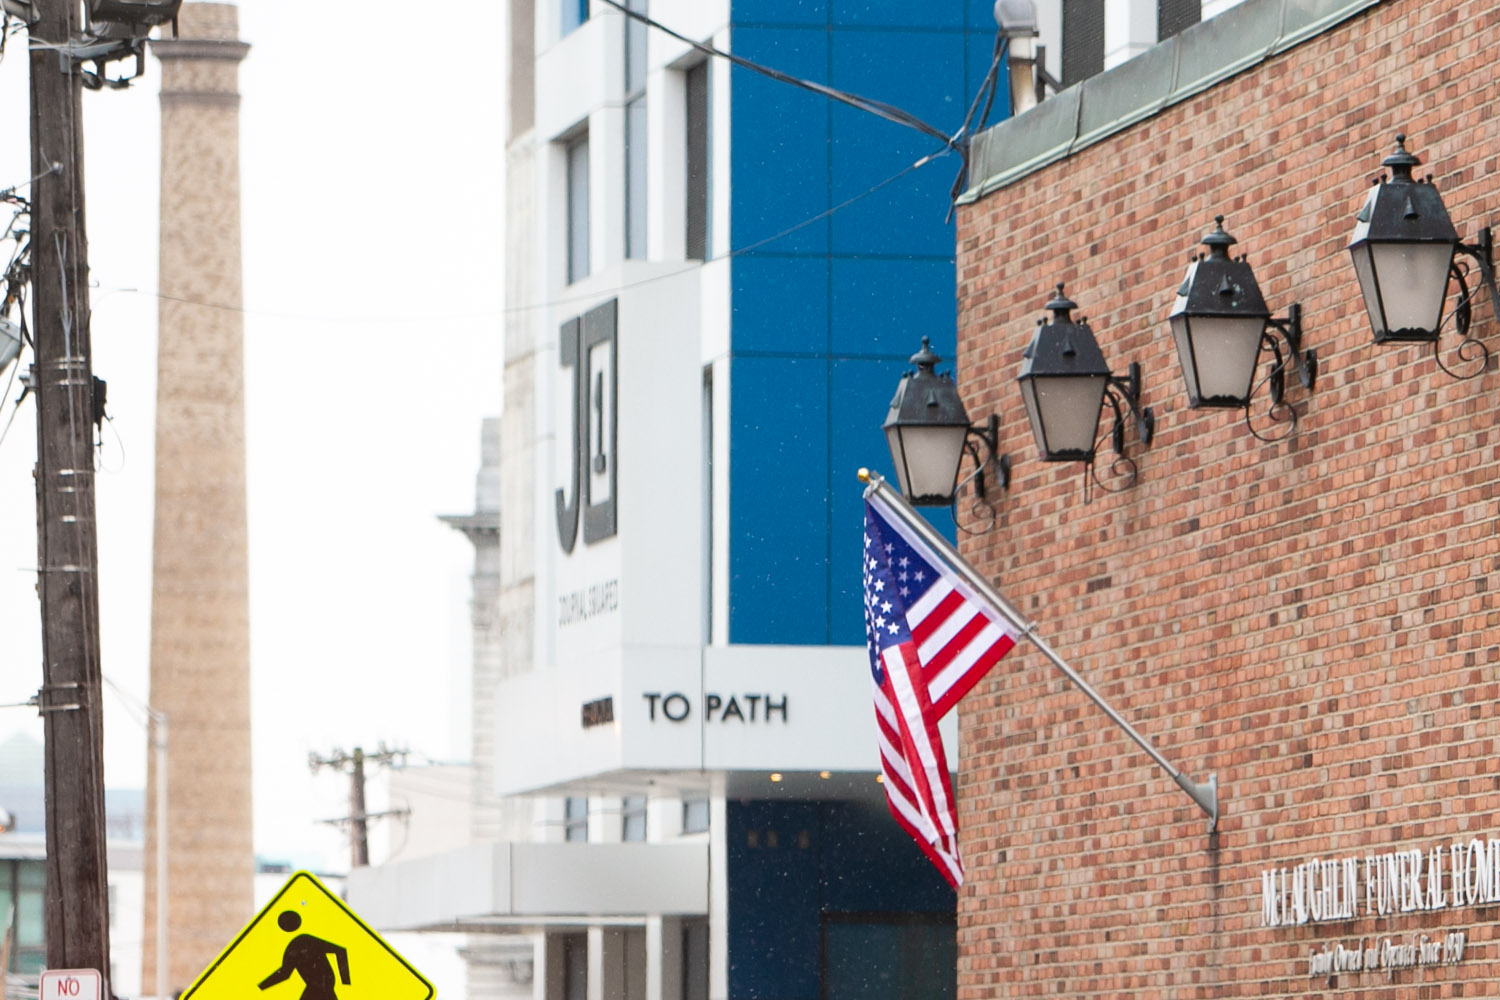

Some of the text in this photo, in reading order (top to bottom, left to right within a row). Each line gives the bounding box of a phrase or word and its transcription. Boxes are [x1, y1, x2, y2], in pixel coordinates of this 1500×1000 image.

[643, 692, 788, 723] TO PATH
[1261, 856, 1358, 927] McLAUGHLIN
[1365, 845, 1447, 916] FUNERAL
[58, 978, 80, 996] NO
